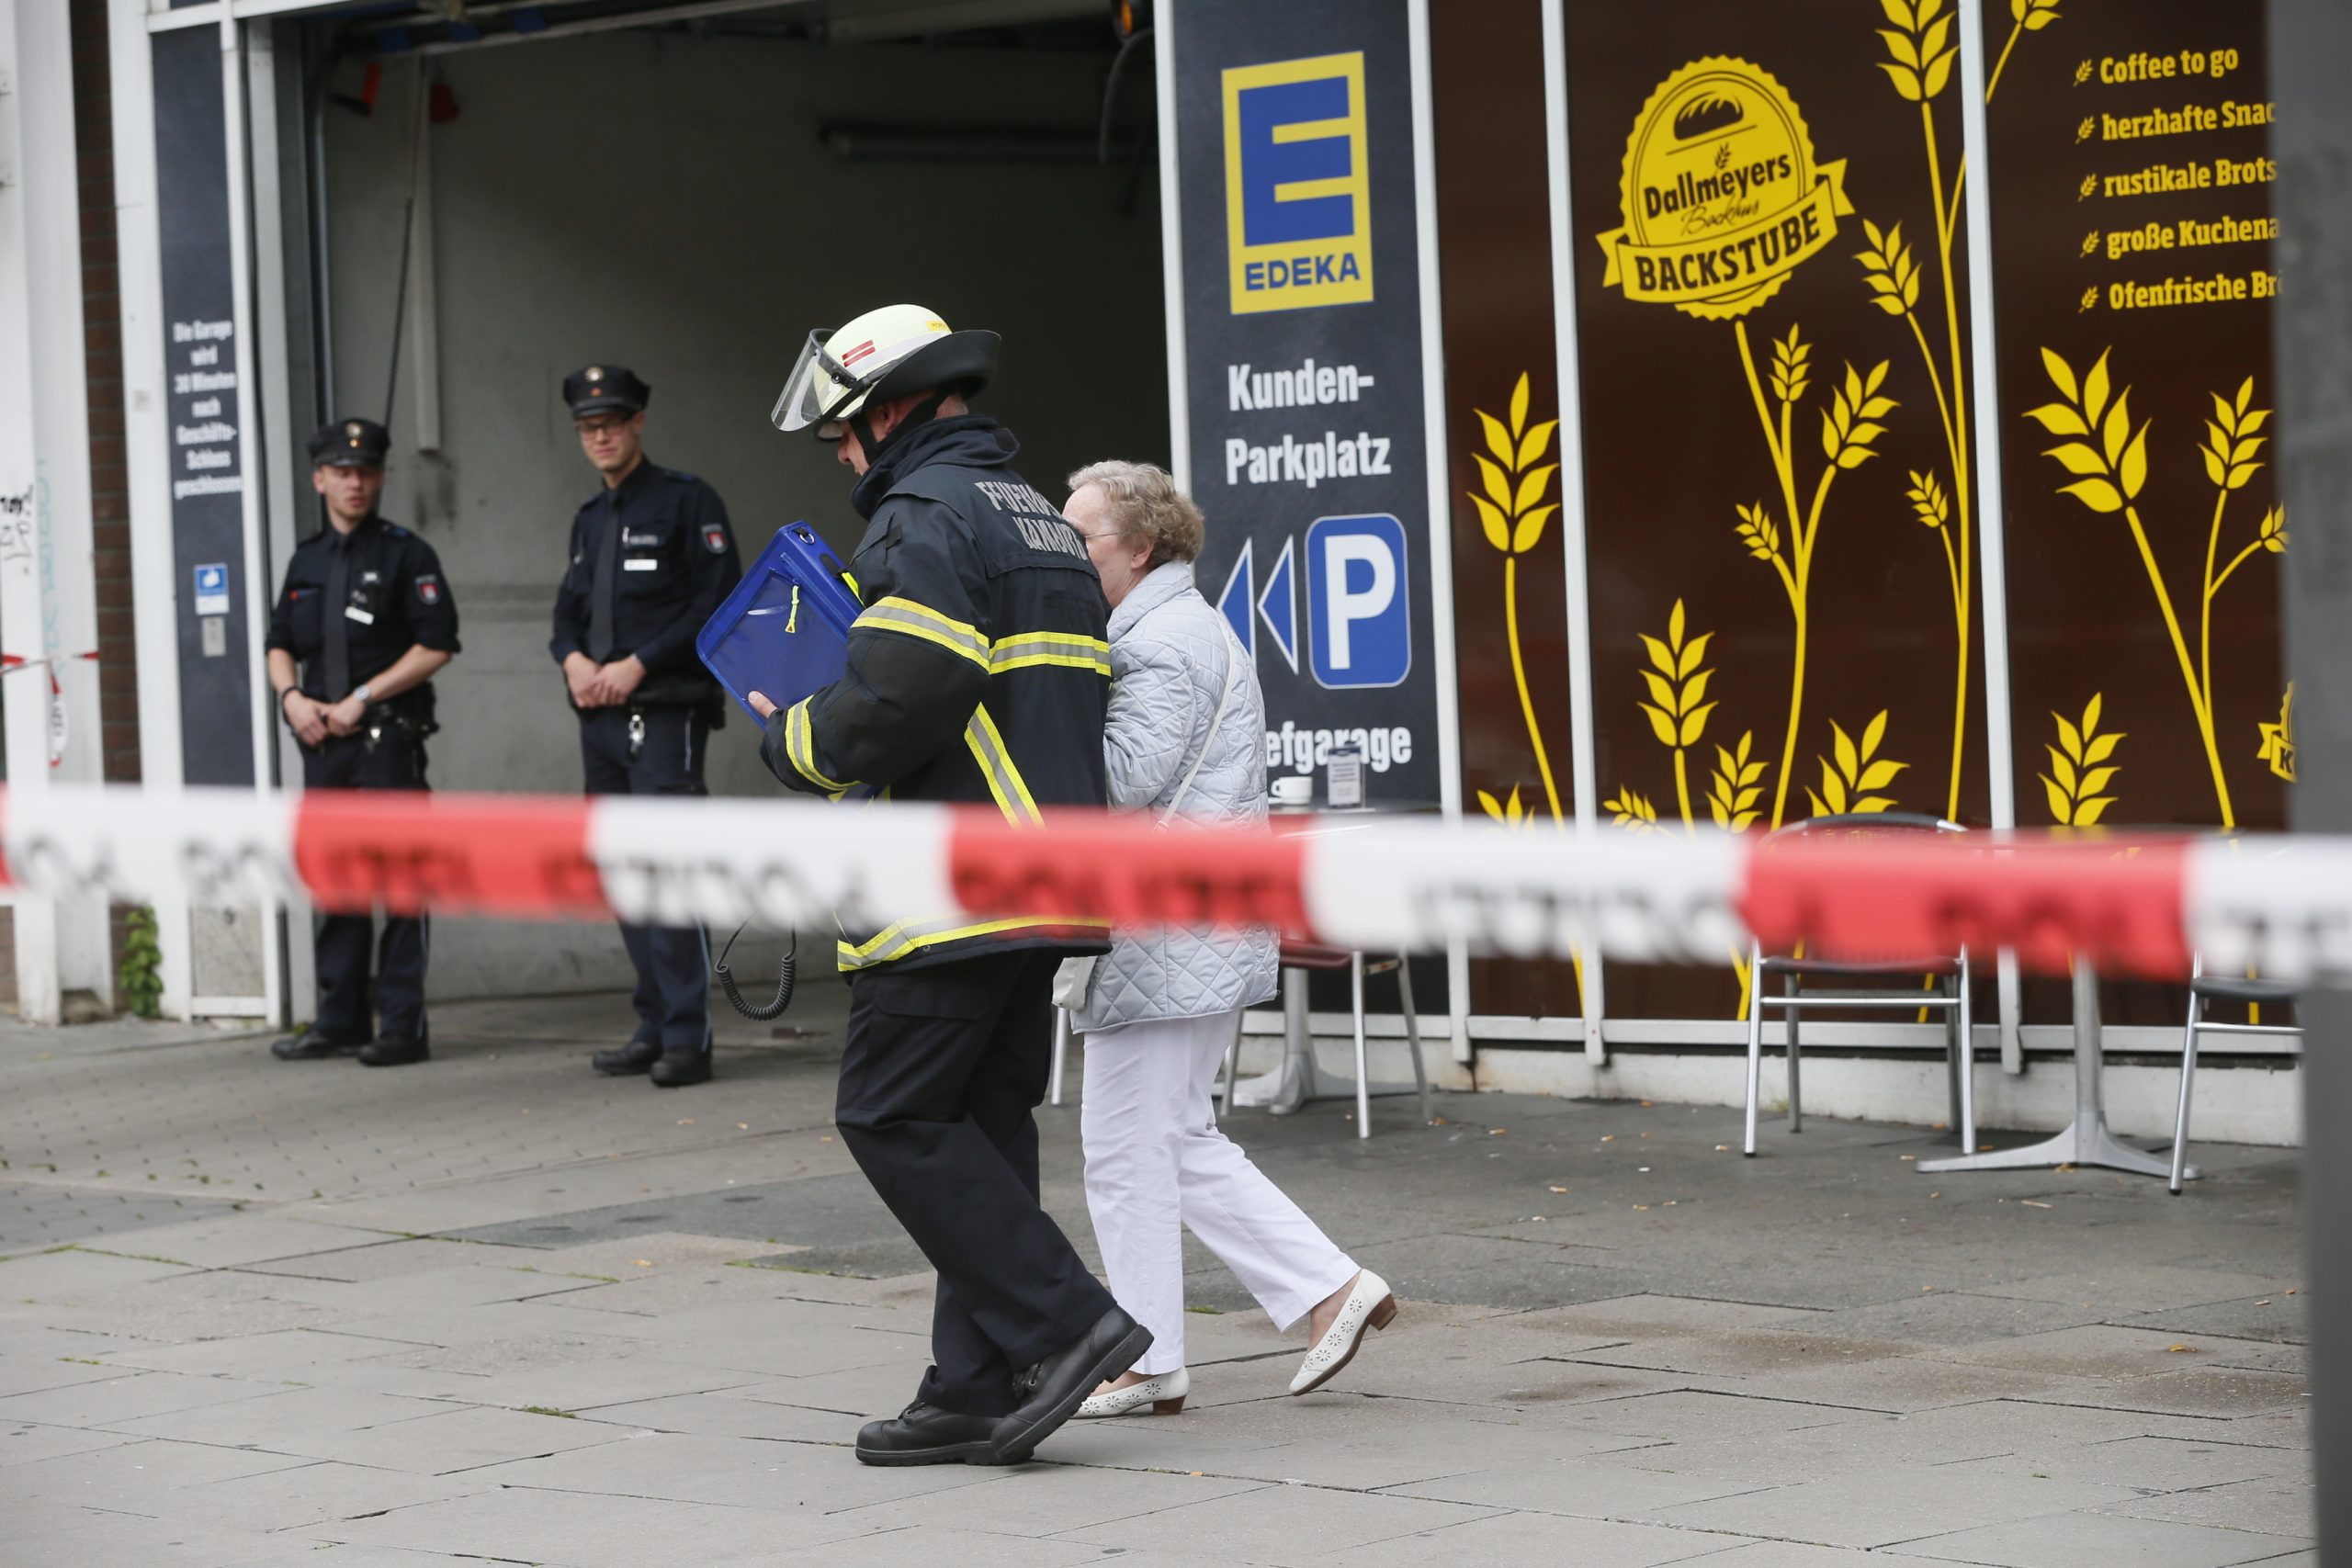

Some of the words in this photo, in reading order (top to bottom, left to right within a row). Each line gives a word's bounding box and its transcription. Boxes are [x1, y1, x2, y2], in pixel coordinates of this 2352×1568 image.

[2100, 51, 2176, 85] Coffee
[2180, 49, 2205, 75] to
[2211, 48, 2239, 78] go
[2101, 104, 2217, 141] herzhafte
[2222, 100, 2278, 129] Snac
[1238, 75, 1354, 247] E
[1644, 152, 1792, 220] Dallmeyers
[2104, 162, 2211, 197] rustikale
[2215, 157, 2278, 186] Brots
[1634, 202, 1821, 292] BACKSTUBE
[2107, 221, 2175, 260] große
[2178, 215, 2281, 248] Kuchena
[1244, 252, 1362, 292] EDEKA
[2109, 273, 2246, 310] Ofenfrische
[1227, 357, 1374, 412] Kunden-
[1226, 430, 1392, 489] Parkplatz
[1325, 534, 1396, 671] P
[1266, 720, 1412, 774] efgarage
